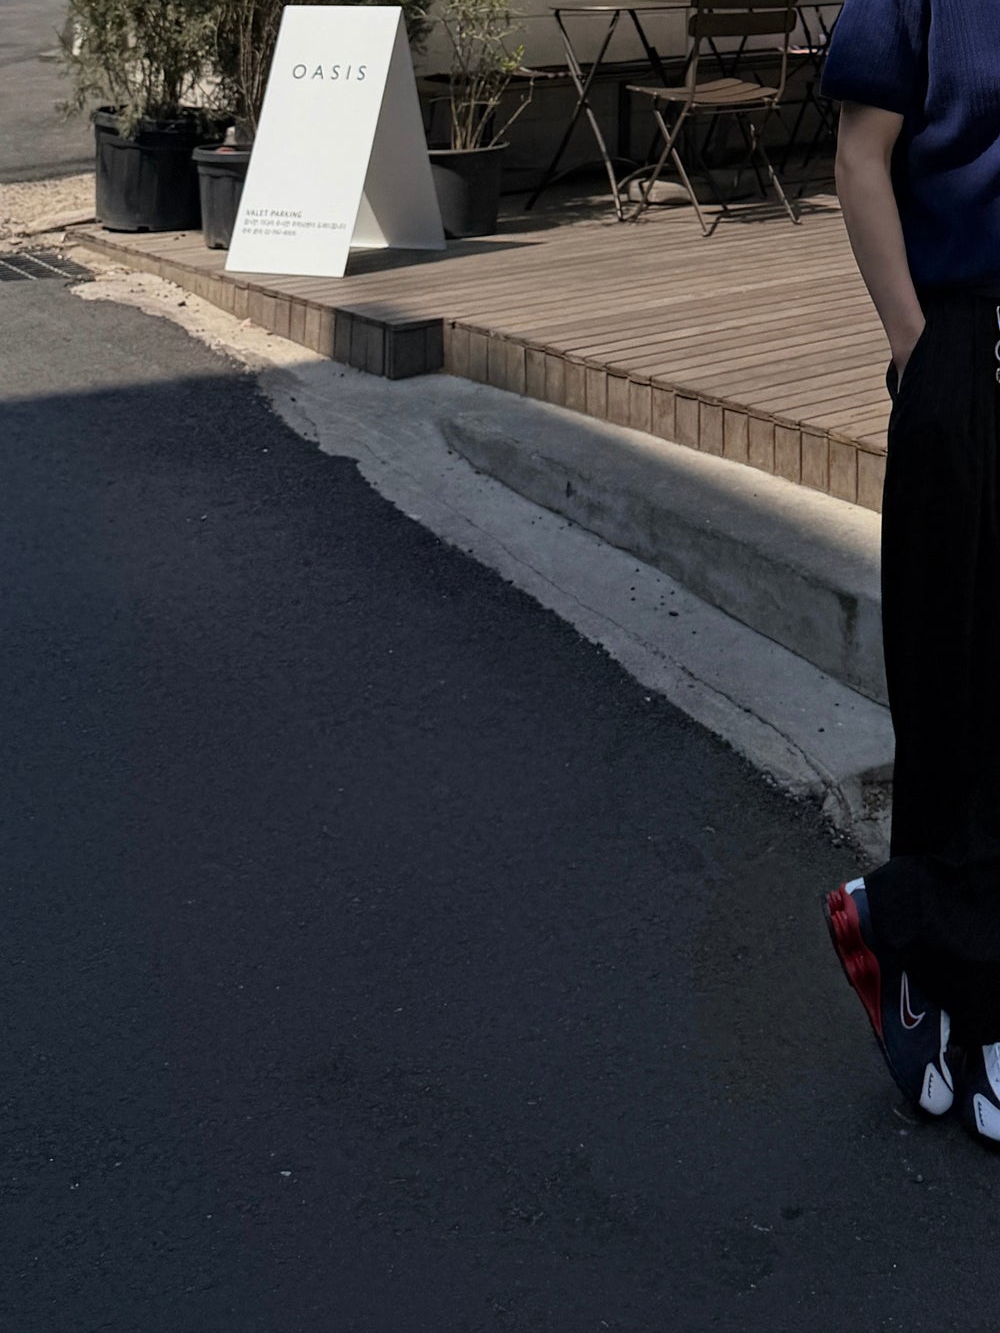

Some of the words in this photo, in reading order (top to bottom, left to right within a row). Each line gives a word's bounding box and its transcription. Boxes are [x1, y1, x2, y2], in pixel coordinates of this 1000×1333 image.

[292, 64, 367, 80] OASIS
[246, 209, 268, 217] VALET
[270, 210, 303, 218] PARKING
